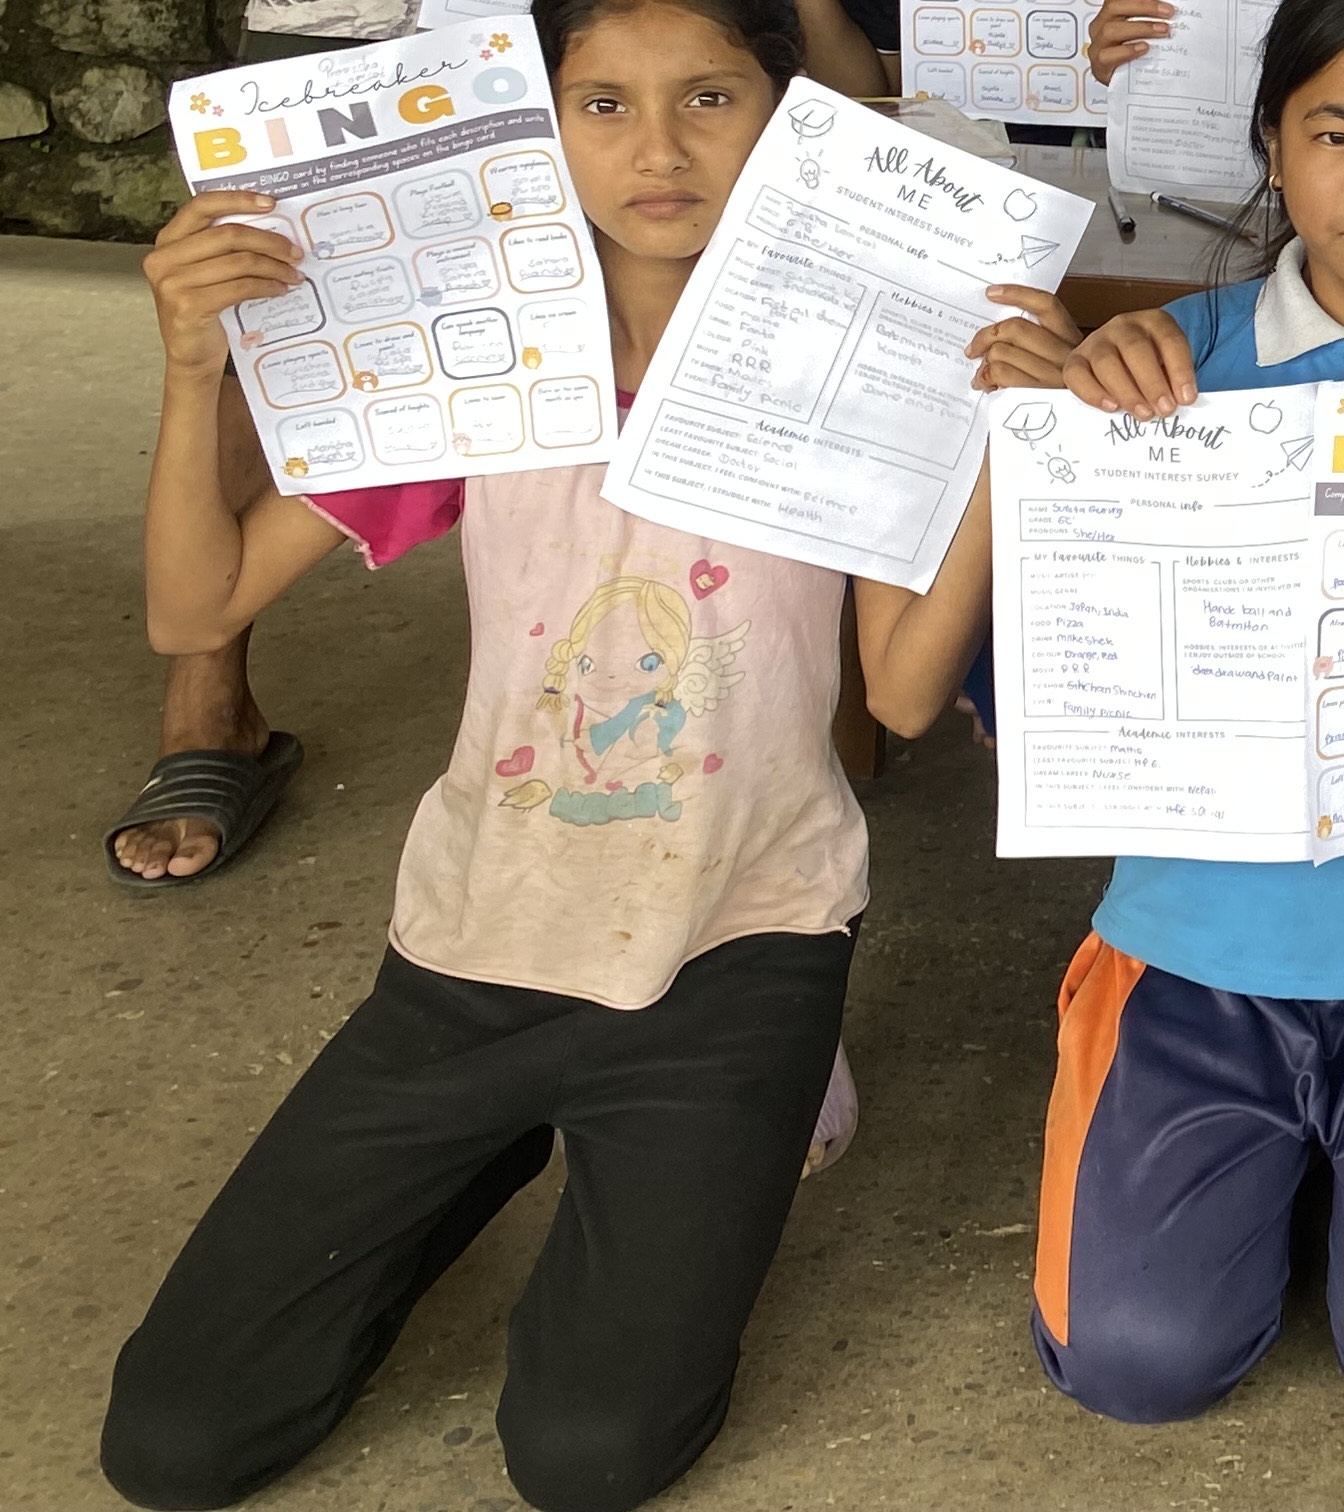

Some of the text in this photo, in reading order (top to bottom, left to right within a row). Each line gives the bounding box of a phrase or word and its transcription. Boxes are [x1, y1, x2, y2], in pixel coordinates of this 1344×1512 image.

[240, 58, 468, 115] Icebreaker
[193, 67, 528, 171] BINGO
[864, 146, 985, 213] All About
[897, 185, 933, 210] ME
[836, 186, 974, 248] STUDENT INTEREST SURVEY
[859, 224, 929, 260] PERSONAL info
[761, 245, 814, 269] favourite
[755, 419, 810, 444] Academic
[1104, 413, 1232, 451] All About
[1149, 446, 1182, 463] ME
[1094, 468, 1239, 482] STUDENT INTEREST SURVEY
[1130, 499, 1203, 511] PERSONAL info
[1053, 552, 1107, 563] favourite
[1185, 555, 1231, 567] Hobbies
[1117, 726, 1172, 740] Academic
